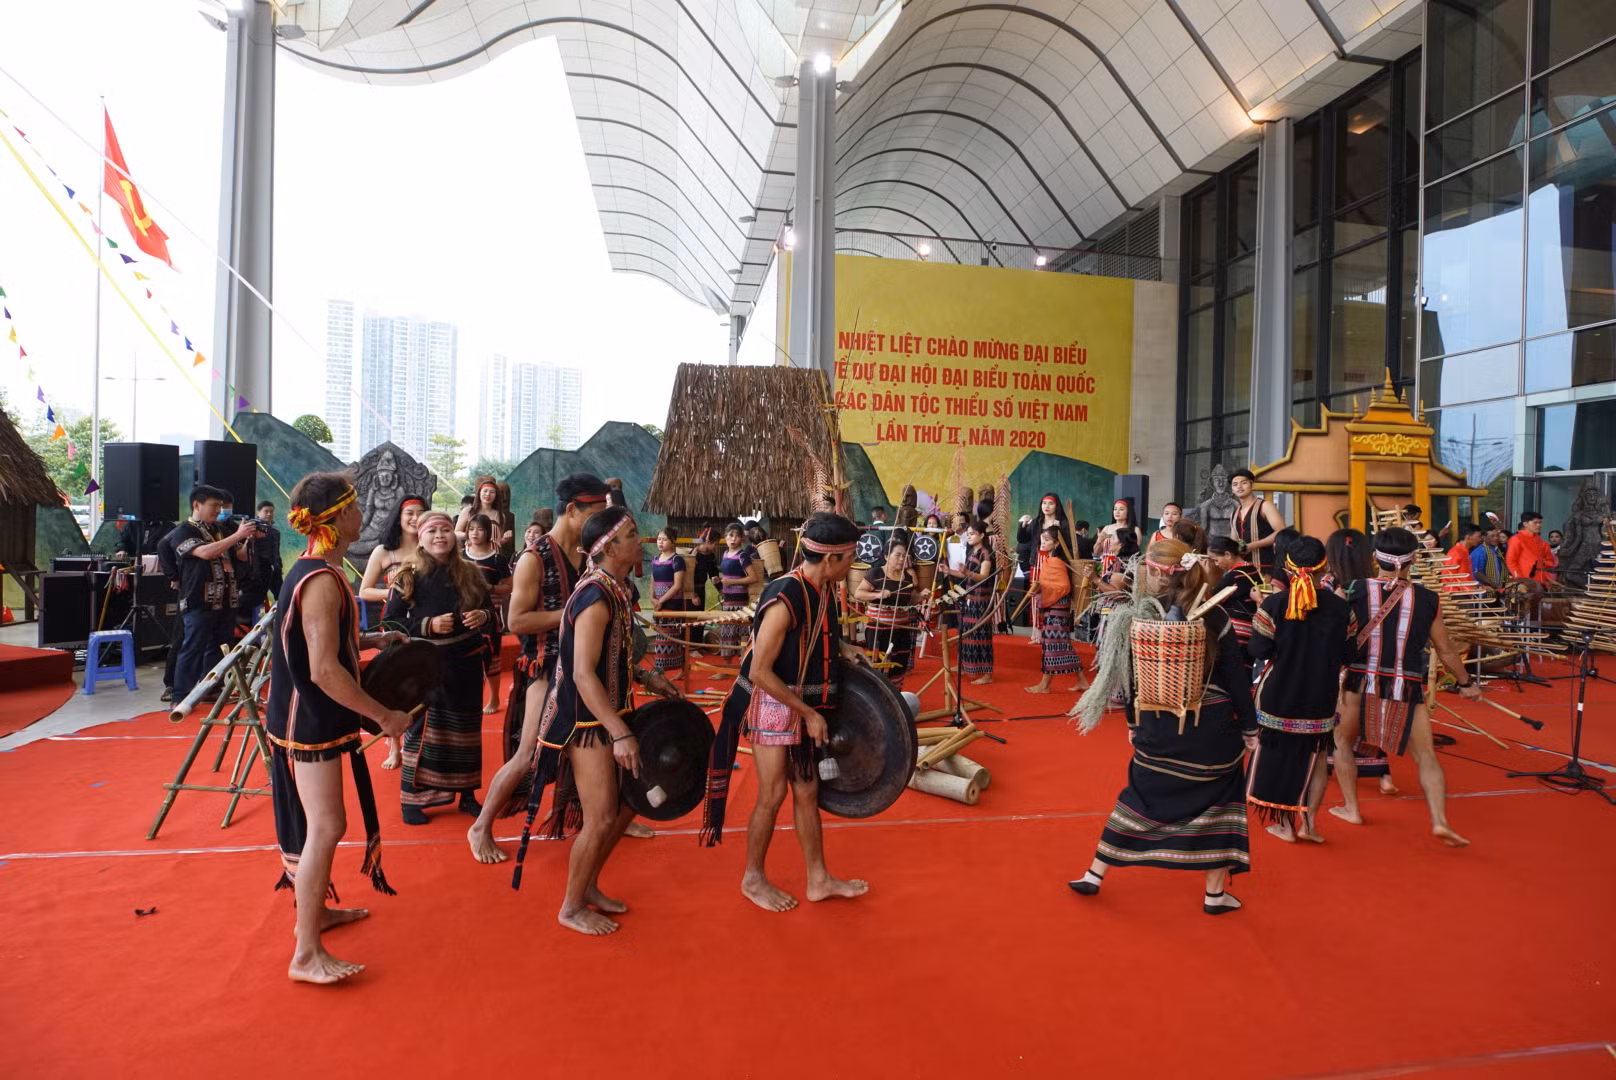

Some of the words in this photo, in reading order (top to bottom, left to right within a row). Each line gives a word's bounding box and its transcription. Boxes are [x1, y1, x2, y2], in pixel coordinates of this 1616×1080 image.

[838, 330, 885, 355] NHIỆT
[890, 332, 922, 357] LIỆT
[927, 335, 968, 357] CHÀO
[973, 338, 1019, 361] MỪNG
[1023, 345, 1048, 366] ĐẠI
[1053, 341, 1087, 366] BIỂU
[852, 362, 876, 385] DỰ
[879, 364, 905, 387] ĐẠI
[911, 363, 937, 388] HỘI
[942, 368, 968, 391] ĐẠI
[973, 364, 1007, 389] BIỂU
[1012, 368, 1051, 392] TOÀN
[1056, 370, 1095, 394] QUỐC
[835, 388, 867, 410] CÁC
[872, 390, 905, 412] DÂN
[910, 392, 940, 417] TỘC
[945, 391, 988, 417] THIỂU
[993, 396, 1014, 418] SỐ
[1018, 399, 1049, 423] VIỆT
[1054, 404, 1088, 422] NAM
[877, 417, 908, 442] LẦN
[913, 421, 944, 443] THỨ
[969, 425, 1005, 446] NĂM
[1009, 430, 1046, 448] 2020
